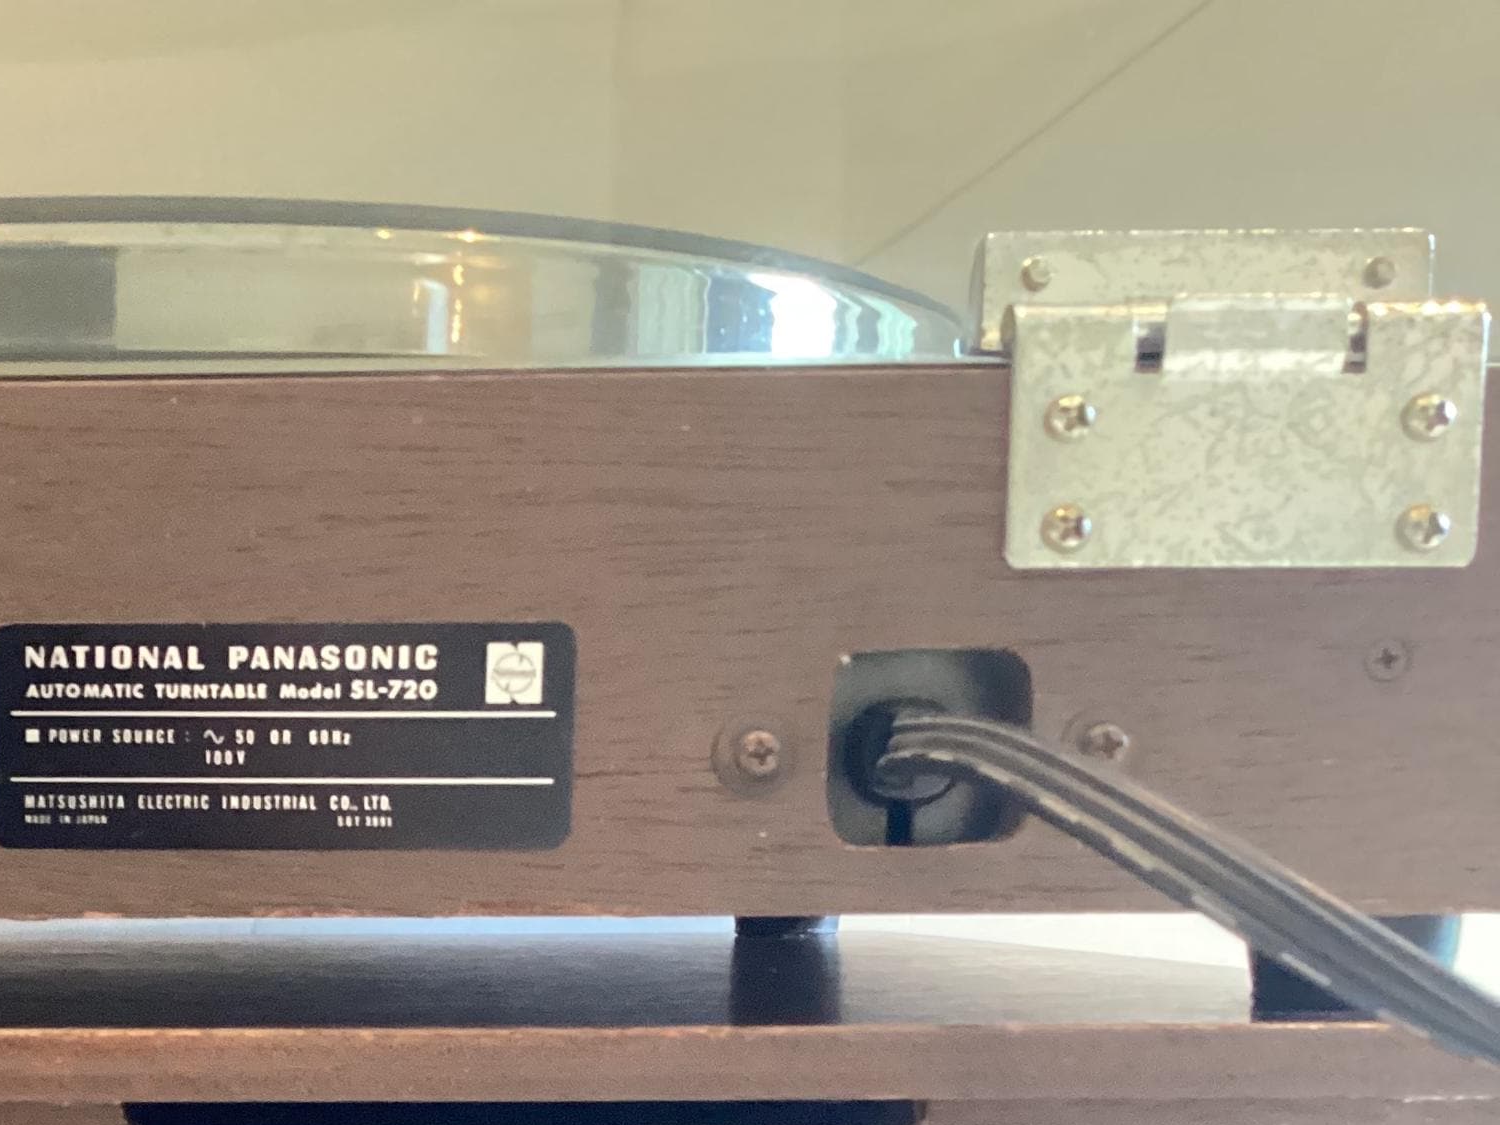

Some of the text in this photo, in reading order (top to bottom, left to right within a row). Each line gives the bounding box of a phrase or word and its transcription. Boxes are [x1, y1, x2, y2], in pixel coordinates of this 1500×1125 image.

[25, 643, 438, 671] NATIONAL PANASONIC
[25, 678, 438, 701] AUTOMATIC TURNTABLE Model SL-720
[48, 728, 102, 744] POWER
[235, 728, 255, 745] 50
[269, 729, 292, 745] OR
[308, 729, 351, 746] 60Hz
[205, 749, 246, 766] 100V
[24, 794, 125, 810] MATSUSHITA
[137, 794, 210, 810] ELECTRIC
[221, 794, 317, 811] INDUSTRIAL
